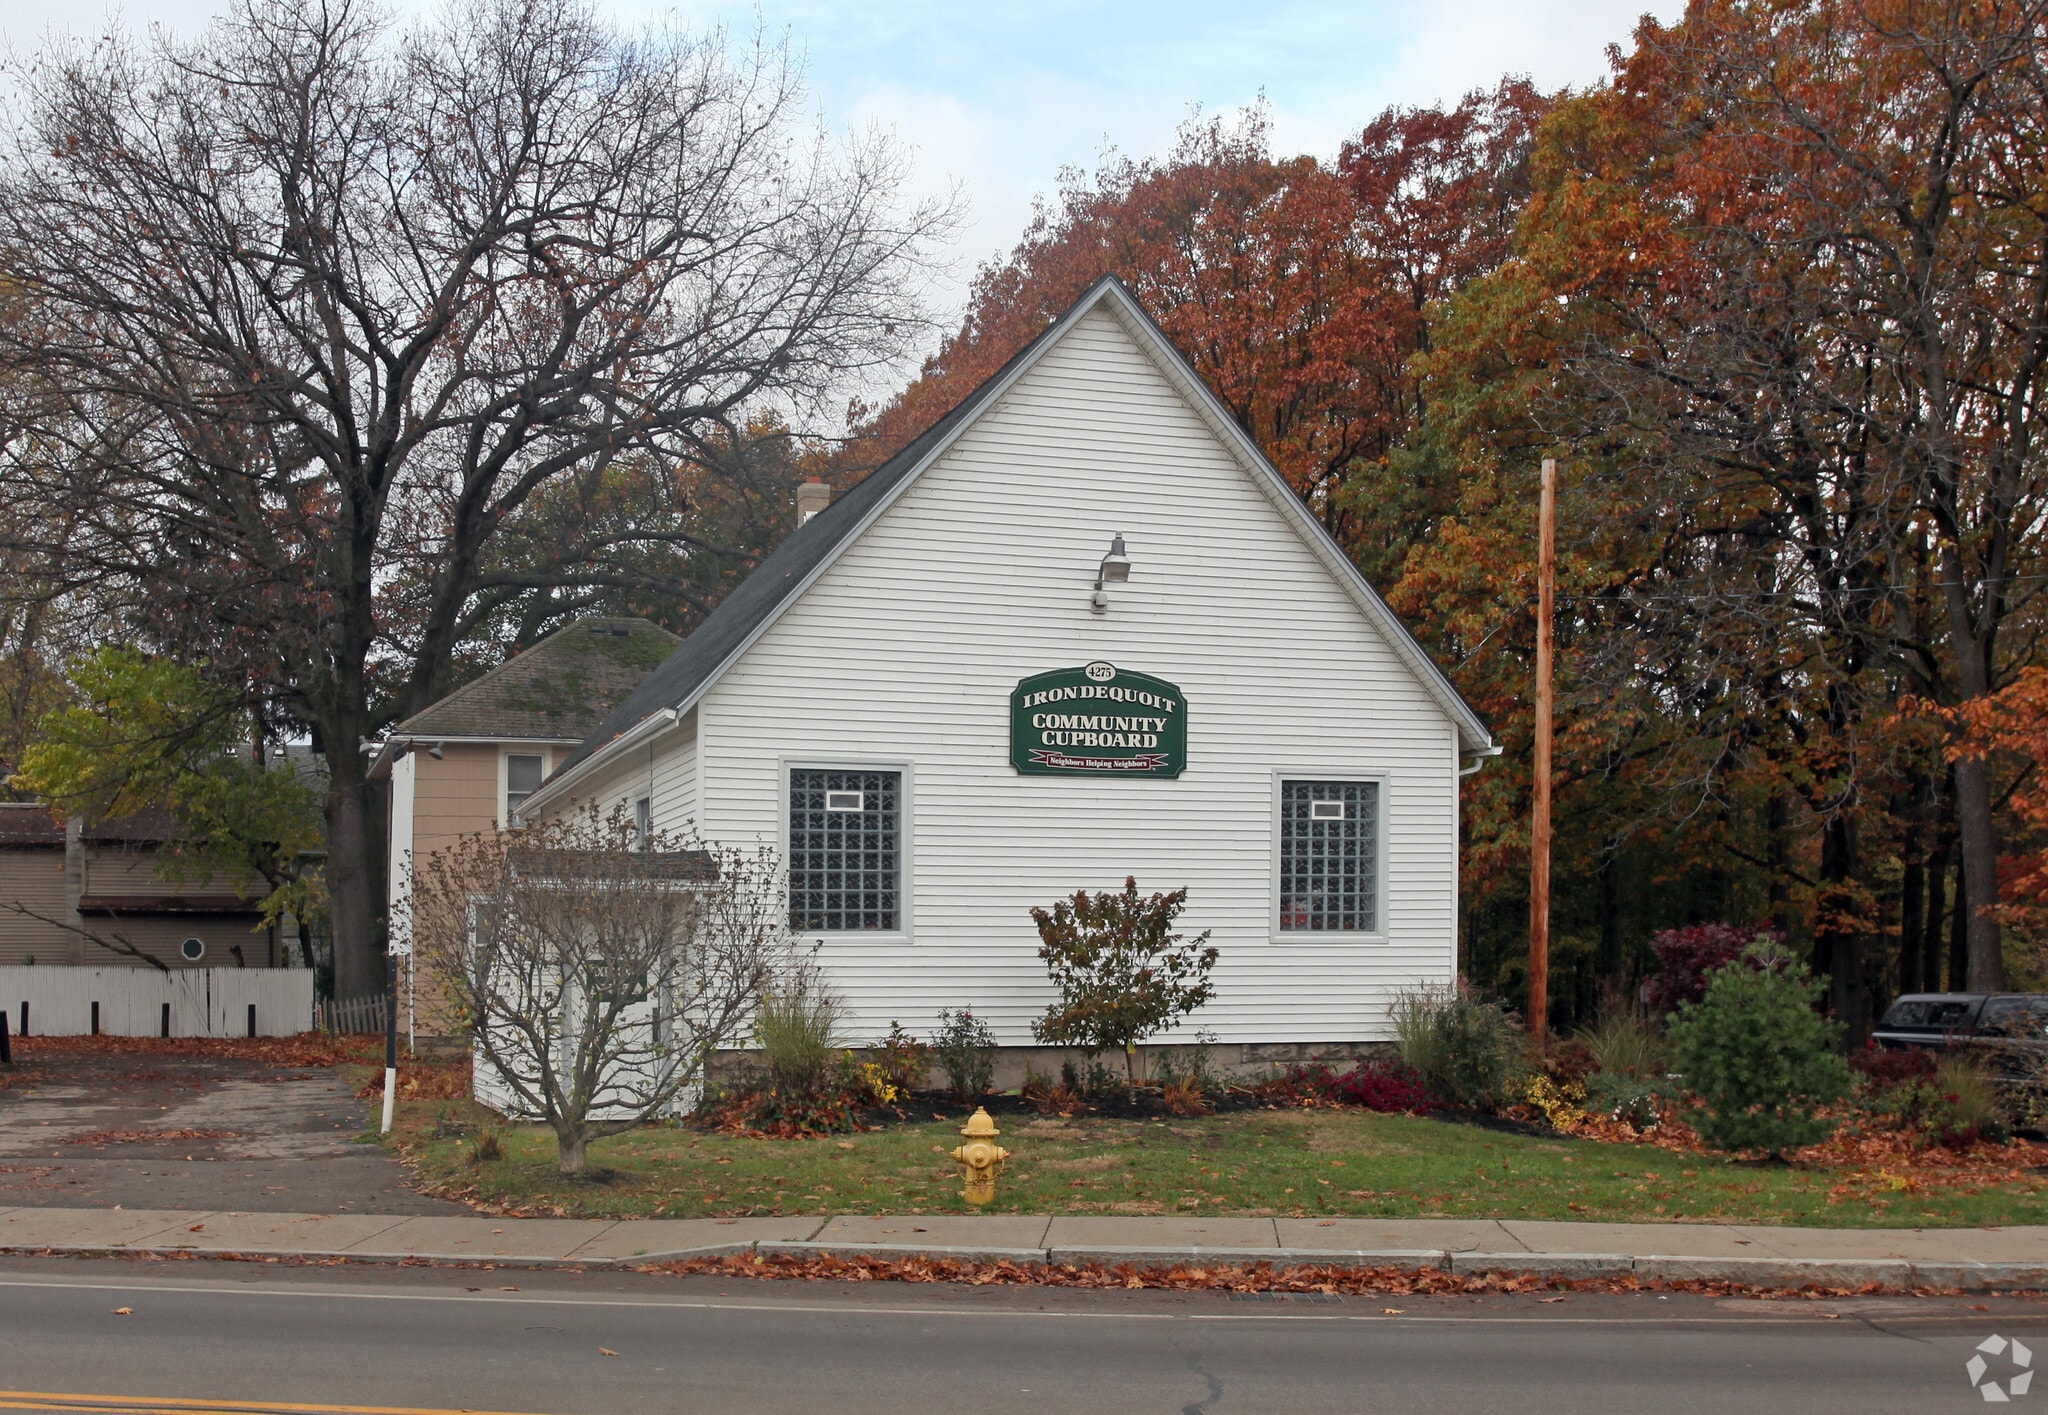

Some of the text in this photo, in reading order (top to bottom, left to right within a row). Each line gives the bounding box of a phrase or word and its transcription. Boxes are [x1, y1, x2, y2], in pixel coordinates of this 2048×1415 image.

[1088, 666, 1112, 678] 4275
[1022, 685, 1176, 713] IRONDEQUOIT
[1032, 713, 1168, 732] COMMUNITY
[1041, 730, 1158, 748] CUPBOARD
[1050, 756, 1147, 769] Neighbors Helping Neighbors
